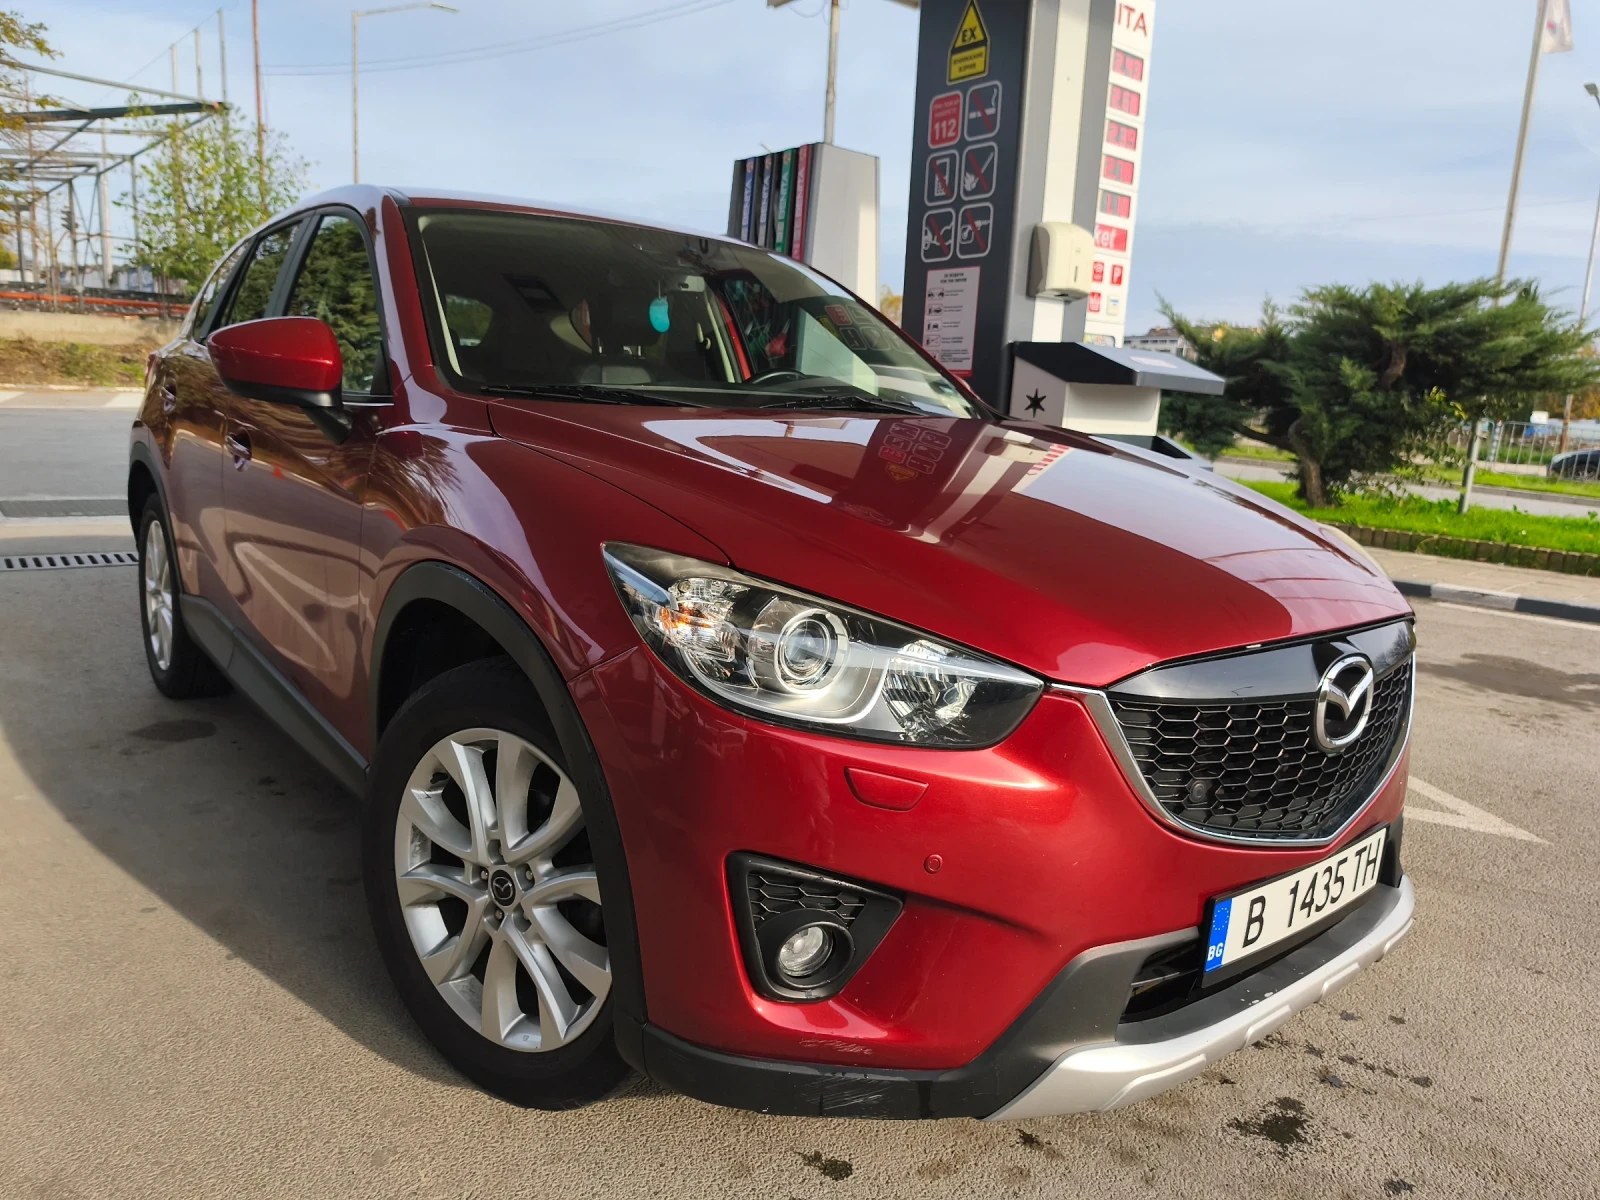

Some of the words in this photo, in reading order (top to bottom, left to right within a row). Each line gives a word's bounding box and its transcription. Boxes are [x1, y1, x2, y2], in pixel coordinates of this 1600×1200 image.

[961, 27, 977, 43] EX
[933, 118, 957, 141] 112
[1112, 266, 1122, 283] P
[1242, 895, 1266, 949] B
[1286, 857, 1348, 929] 1435
[1352, 837, 1382, 892] TH
[1207, 943, 1224, 961] BG
